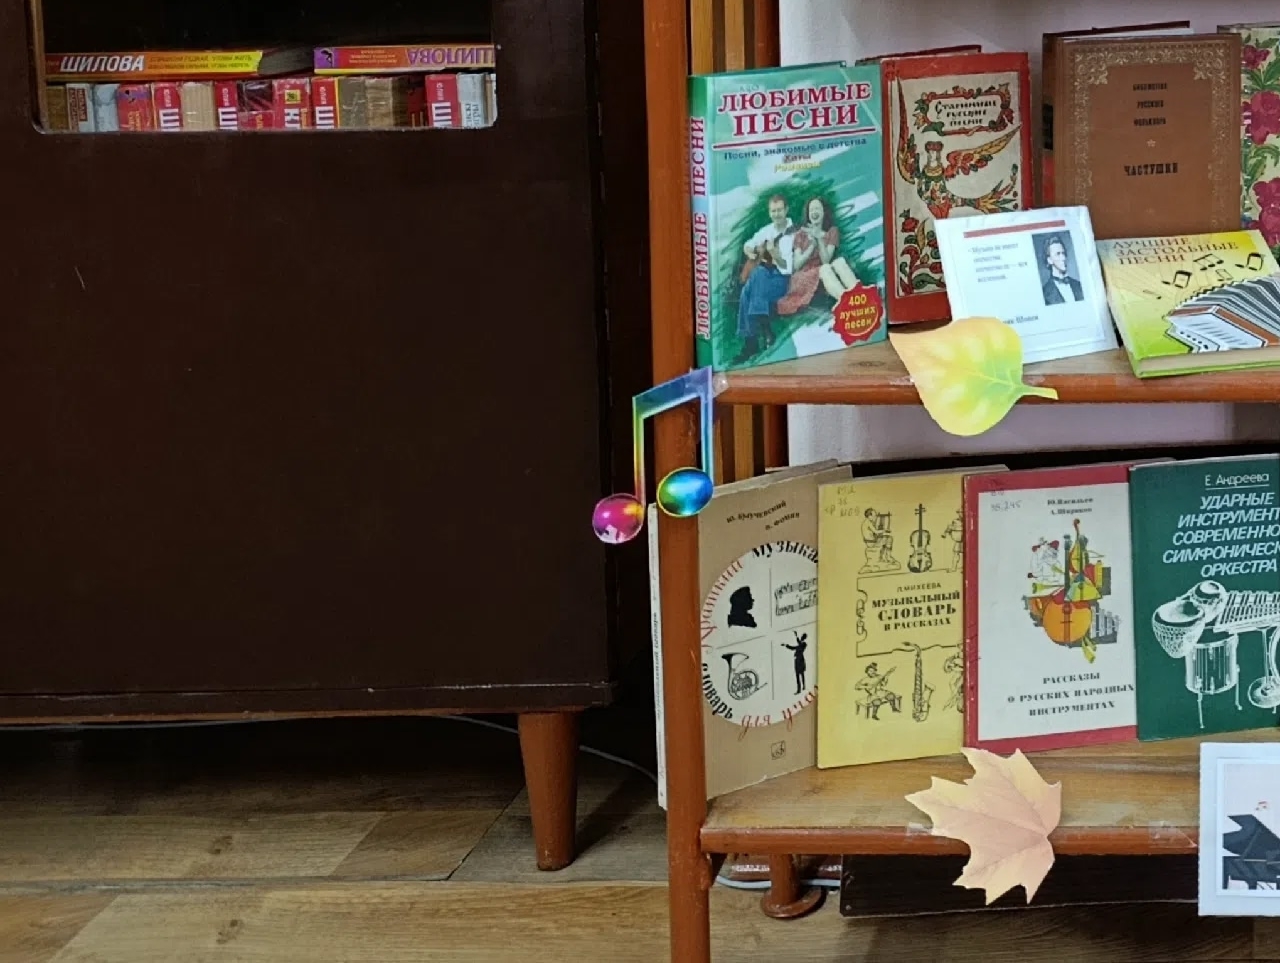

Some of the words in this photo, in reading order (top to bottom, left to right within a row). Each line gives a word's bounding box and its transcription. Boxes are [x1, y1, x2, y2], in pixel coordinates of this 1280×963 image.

[60, 56, 146, 73] ШИЛОВА
[718, 83, 871, 113] ЛЮБИМЫЕ
[733, 103, 858, 136] ПЕСНИ
[690, 117, 706, 197] ПЕСНИ
[724, 149, 761, 161] Песни,
[764, 143, 816, 156] знакомые
[827, 138, 867, 150] детства
[1124, 163, 1178, 176] ЧАСТУШКИ
[1113, 237, 1191, 250] ЛУЧШИЕ
[1116, 242, 1239, 257] ЗАСТОЛЬНЫЕ
[1118, 255, 1186, 265] ПЕСНИ
[692, 212, 711, 339] ЛЮБИМЫЕ
[848, 293, 867, 307] 400
[839, 305, 877, 321] лучших
[844, 317, 873, 330] песен
[1216, 473, 1270, 487] Андреева
[1200, 492, 1275, 510] УДАРНЫЕ
[1201, 558, 1278, 577] ОРКЕСТРА
[872, 590, 960, 608] МУЗЫКАЛЬНЫЙ
[878, 603, 956, 621] СЛОВАРЬ
[884, 623, 890, 631] В
[894, 618, 951, 630] РАССКАЗАХ
[1042, 672, 1100, 684] РАССКАЗЫ
[1019, 690, 1070, 702] РУССКИХ
[1074, 684, 1135, 697] НАРОДНЫХ
[1028, 701, 1115, 717] ИНСТРУМЕНТАХ
[739, 713, 771, 741] для
